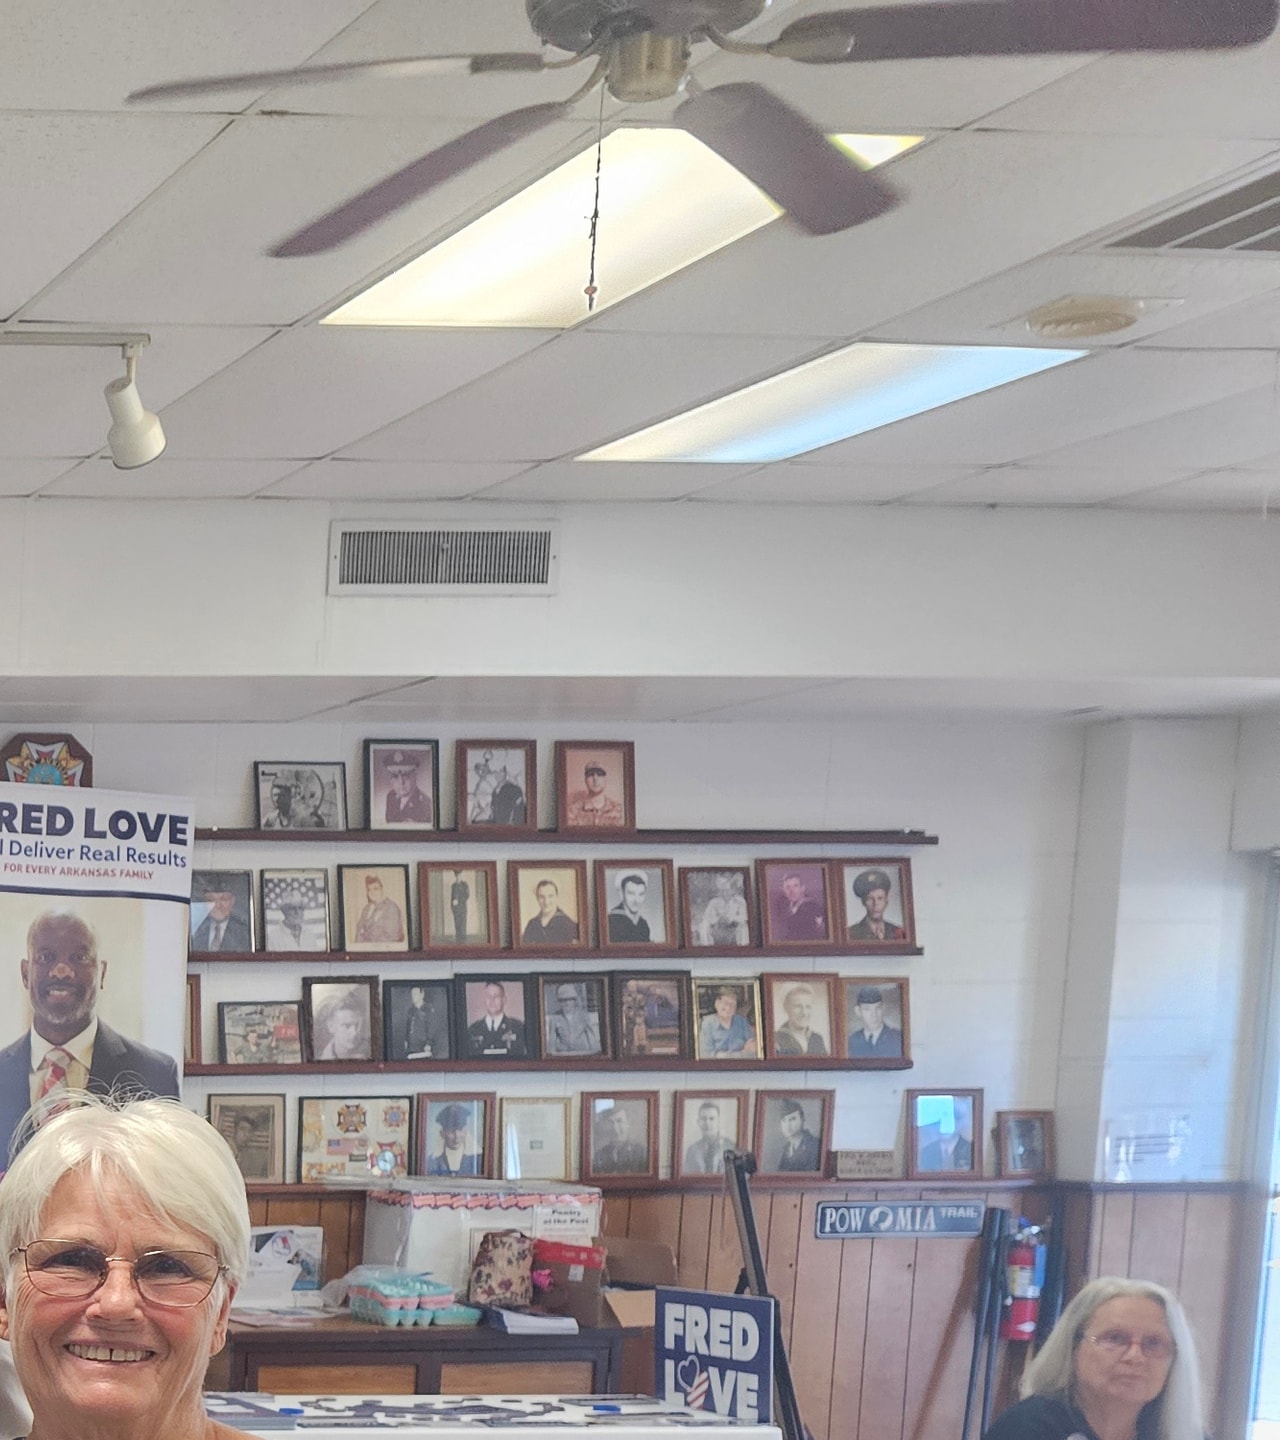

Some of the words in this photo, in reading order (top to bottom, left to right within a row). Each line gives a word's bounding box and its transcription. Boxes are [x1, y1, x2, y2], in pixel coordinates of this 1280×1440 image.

[84, 807, 189, 846] LOVE
[9, 838, 75, 860] Deliver
[80, 843, 121, 862] Real
[126, 846, 187, 868] Results
[3, 862, 23, 874] FOR
[25, 864, 56, 876] EVERY
[59, 866, 117, 878] ARKANSAS
[119, 868, 154, 880] FAMILY
[823, 1207, 867, 1233] POW
[892, 1206, 937, 1231] MIA
[940, 1205, 979, 1218] TRAIL
[664, 1302, 760, 1362] FRED
